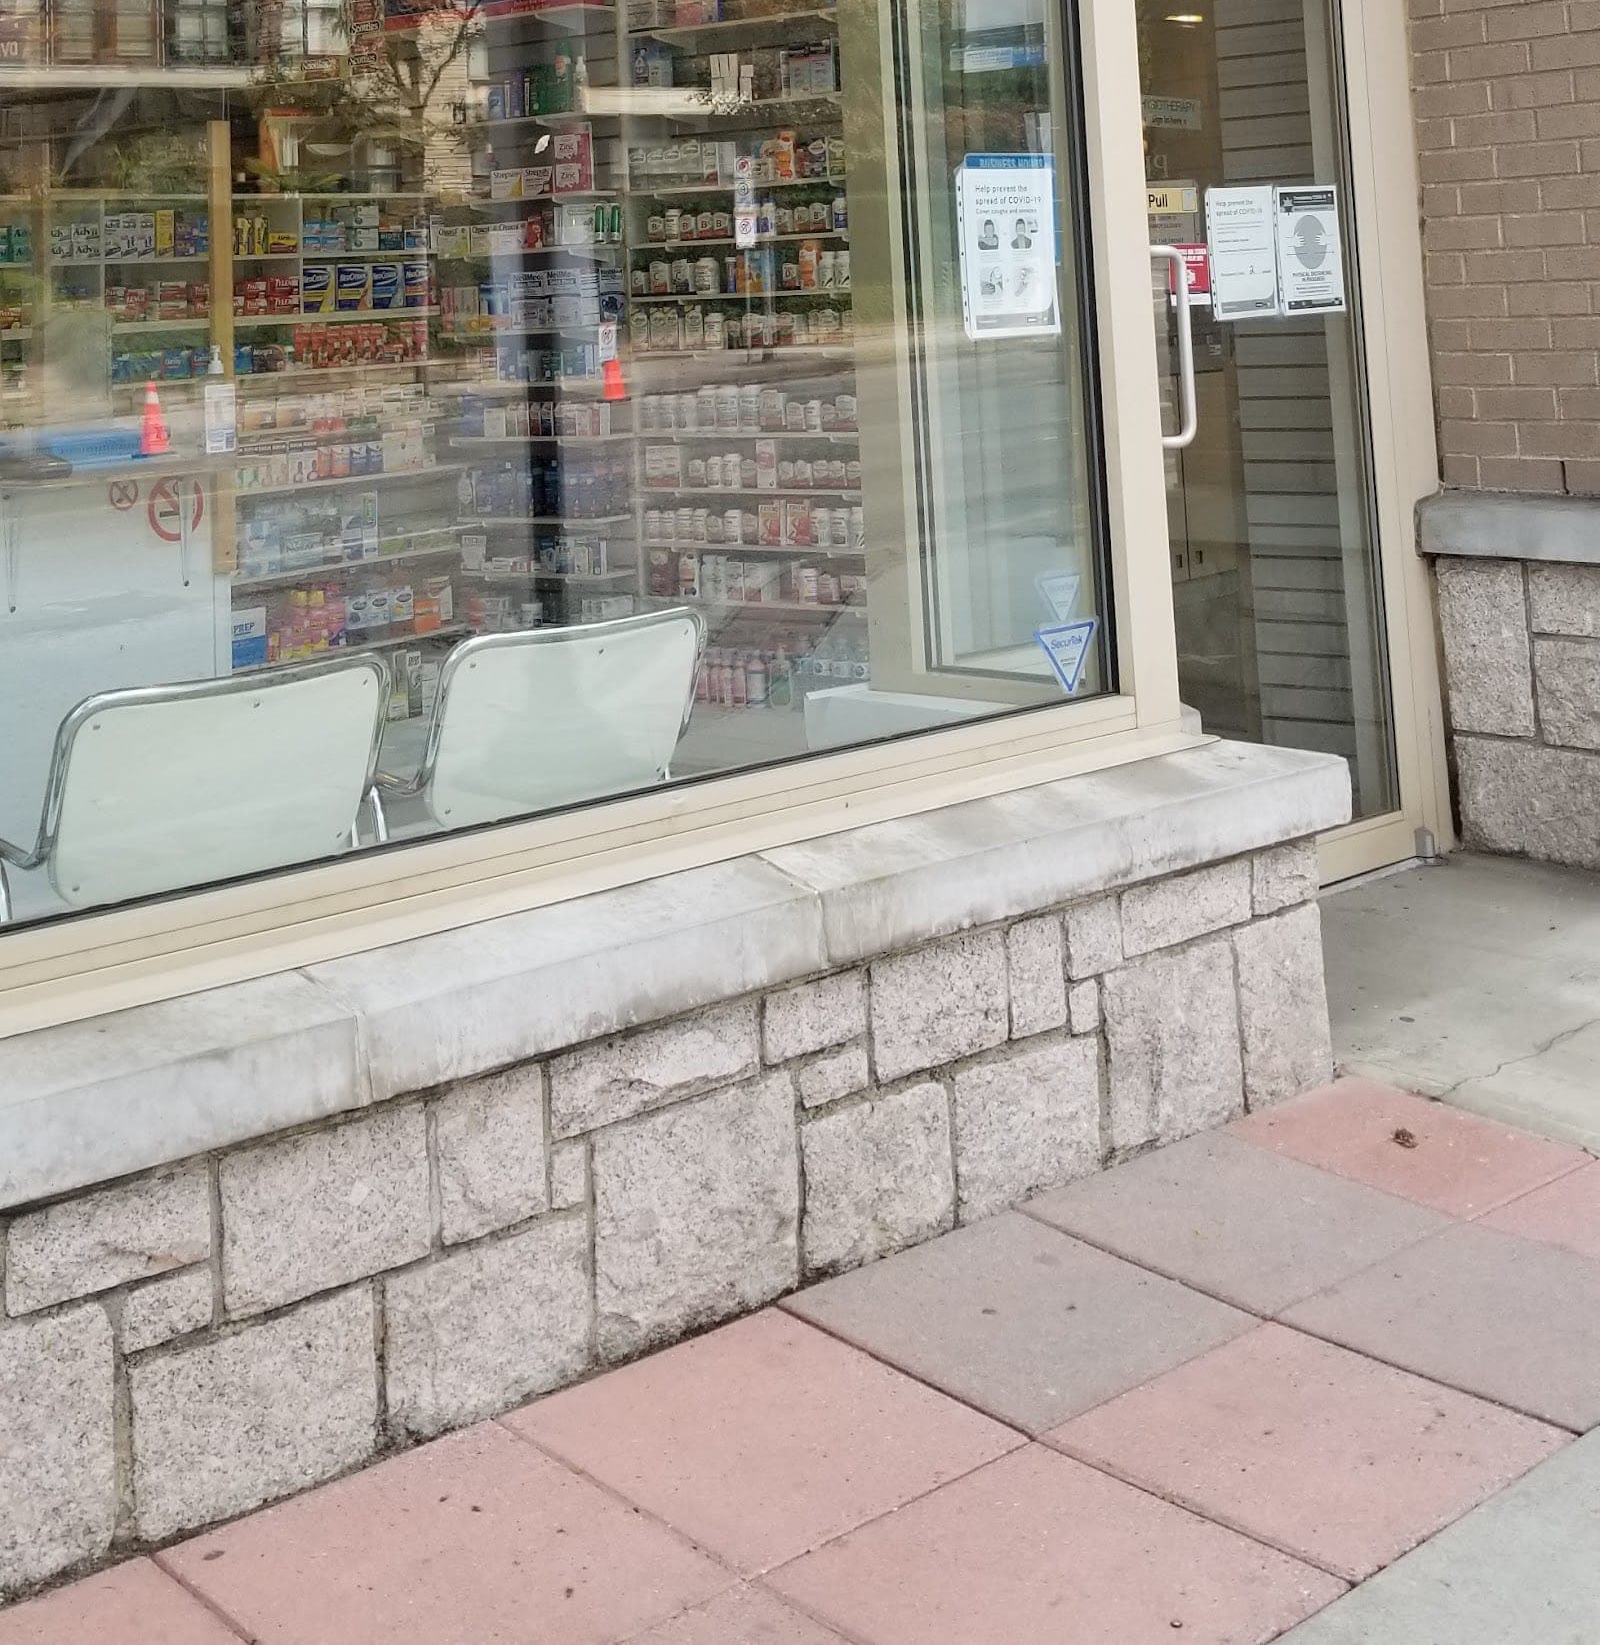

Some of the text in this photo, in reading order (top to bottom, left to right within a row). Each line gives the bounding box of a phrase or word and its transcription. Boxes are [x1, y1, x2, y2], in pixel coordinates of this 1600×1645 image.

[975, 184, 1027, 194] Help prevent the
[975, 195, 998, 205] spread
[999, 195, 1007, 204] of
[1148, 193, 1168, 208] Pull
